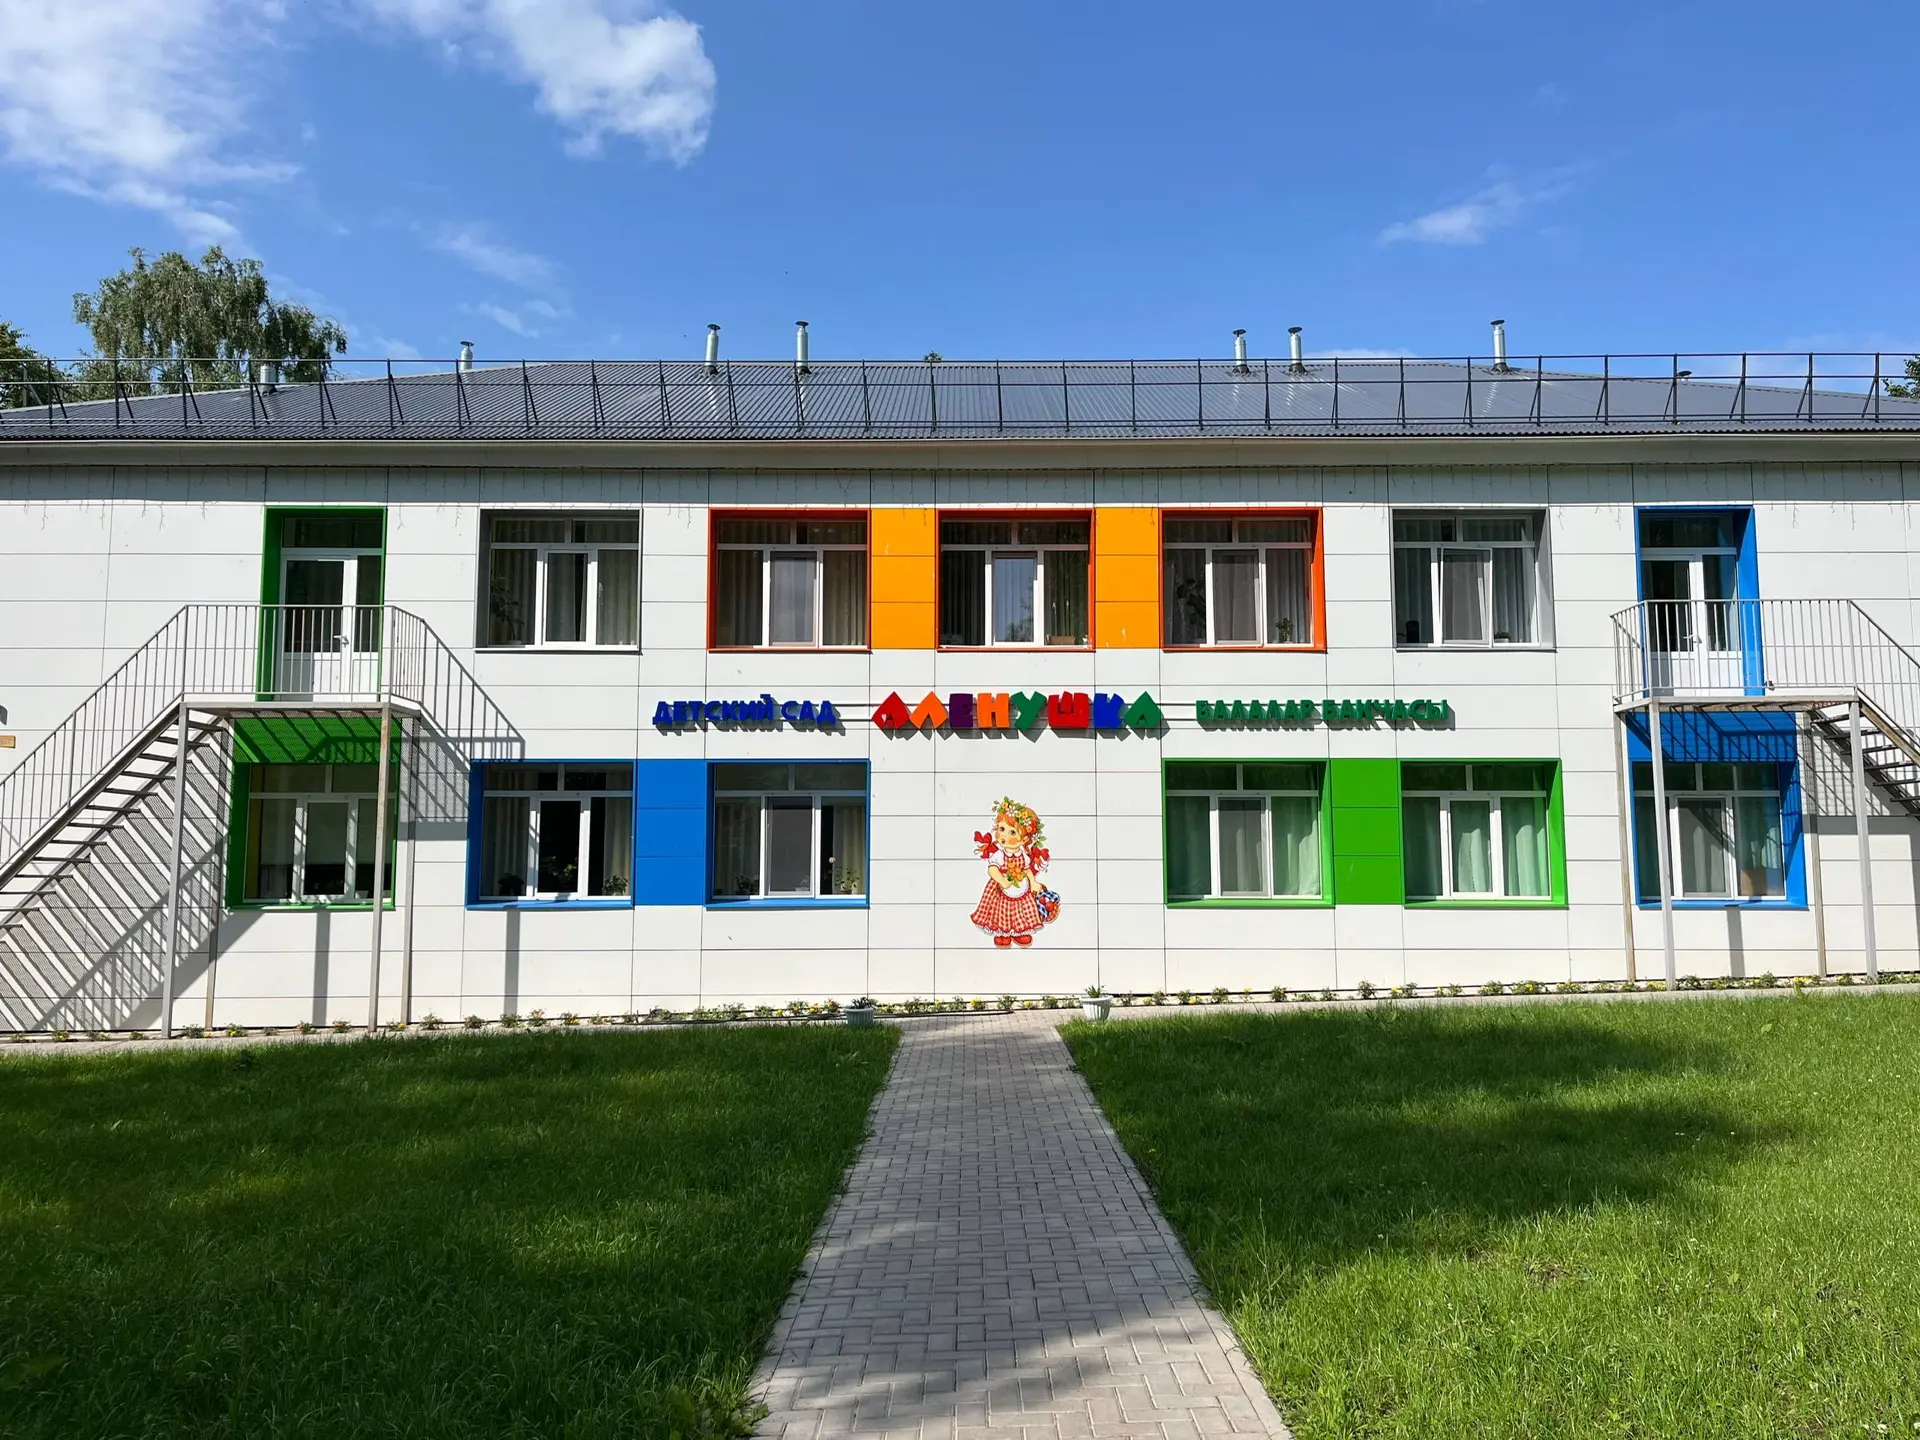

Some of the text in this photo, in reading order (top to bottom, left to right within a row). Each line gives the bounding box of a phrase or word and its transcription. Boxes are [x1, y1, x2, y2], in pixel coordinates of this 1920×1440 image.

[653, 694, 836, 725] ДЕТСКИЙ САД
[871, 691, 1164, 730] АЛЕНУШКА
[1196, 699, 1448, 720] БАЛАЛАР БАКЧАСЫ
